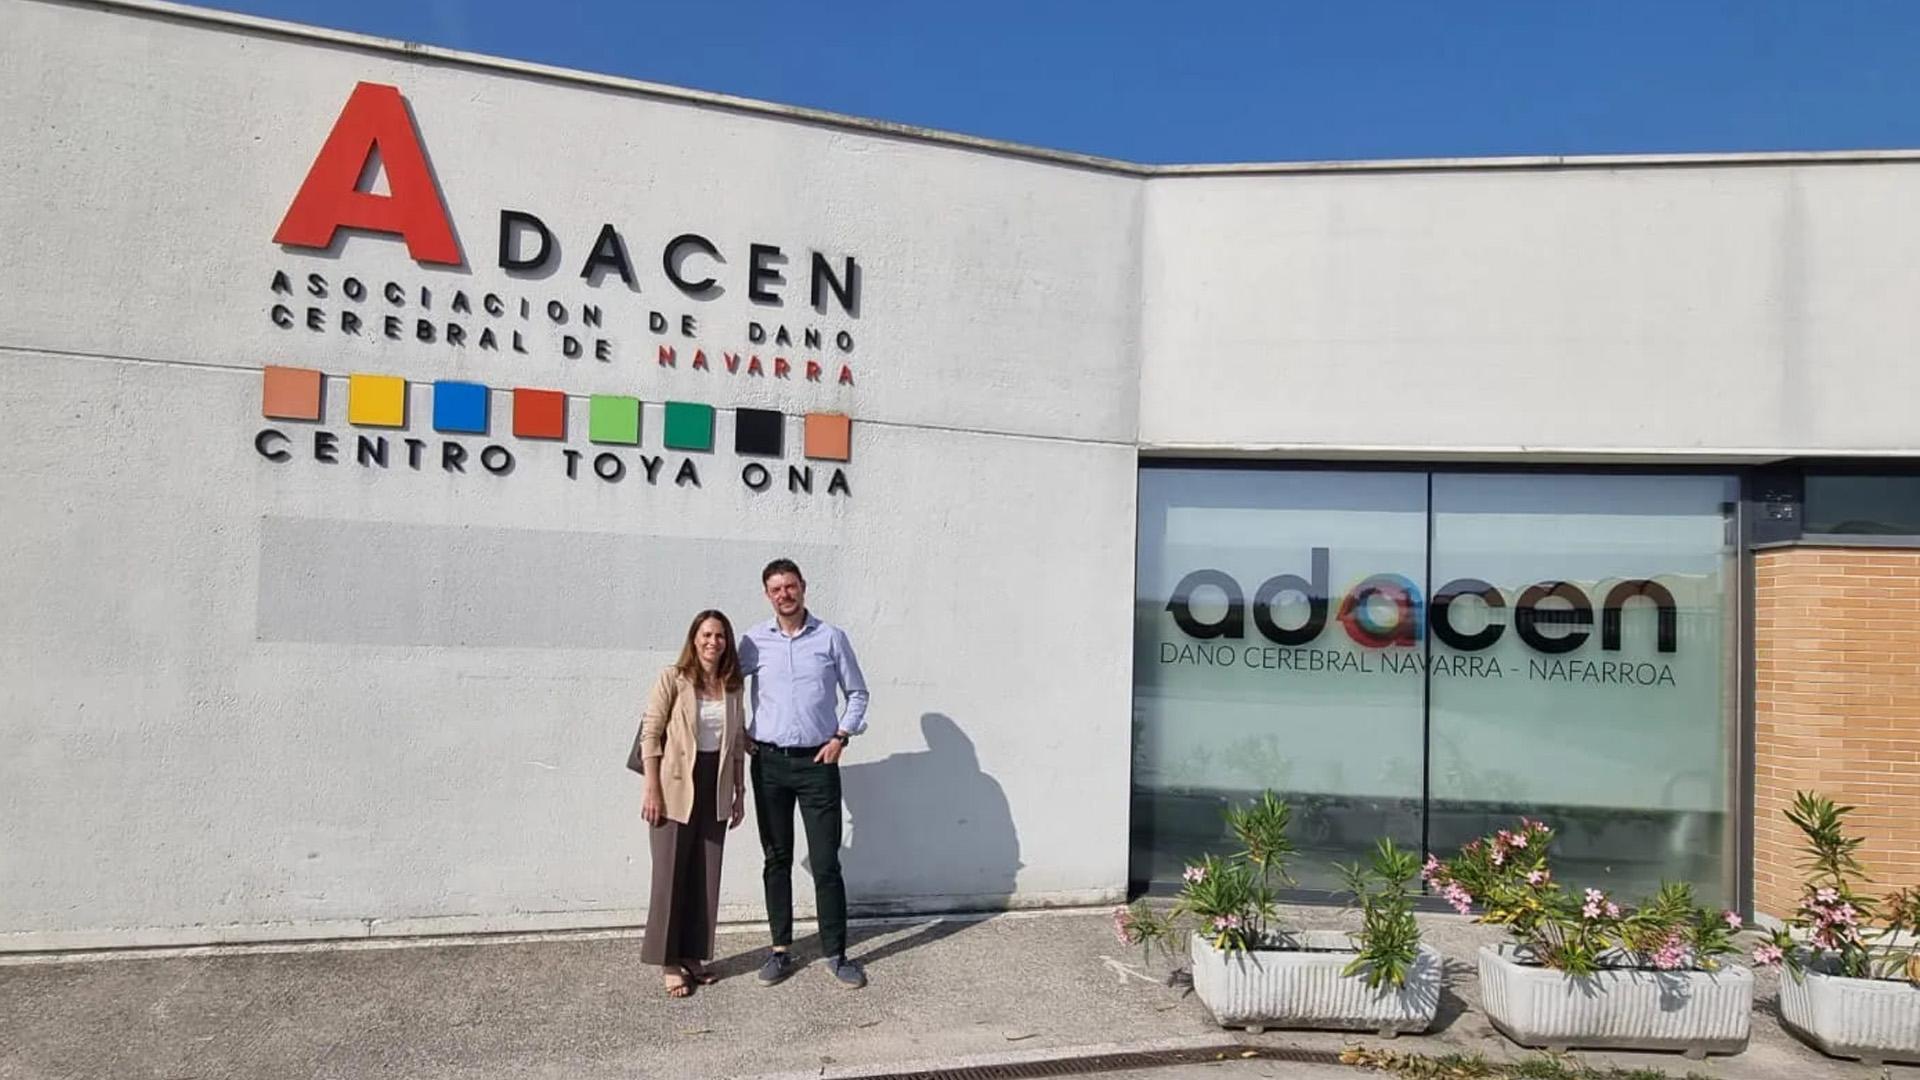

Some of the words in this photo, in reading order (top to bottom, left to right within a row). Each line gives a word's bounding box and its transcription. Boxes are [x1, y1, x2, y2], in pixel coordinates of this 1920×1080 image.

[270, 269, 601, 327] ASOCIACION
[650, 311, 695, 337] DE
[271, 304, 528, 354] CEREBRAL
[563, 335, 611, 361] DE
[659, 345, 854, 386] NAVARRA
[254, 429, 515, 475] CENTRO
[562, 450, 701, 488] TOYA
[741, 462, 851, 495] ONA
[1165, 547, 1677, 653] adacen
[1243, 647, 1373, 673] CEREBRAL
[1381, 652, 1502, 679] NAVARRA
[1529, 658, 1676, 687] NAFARROA
